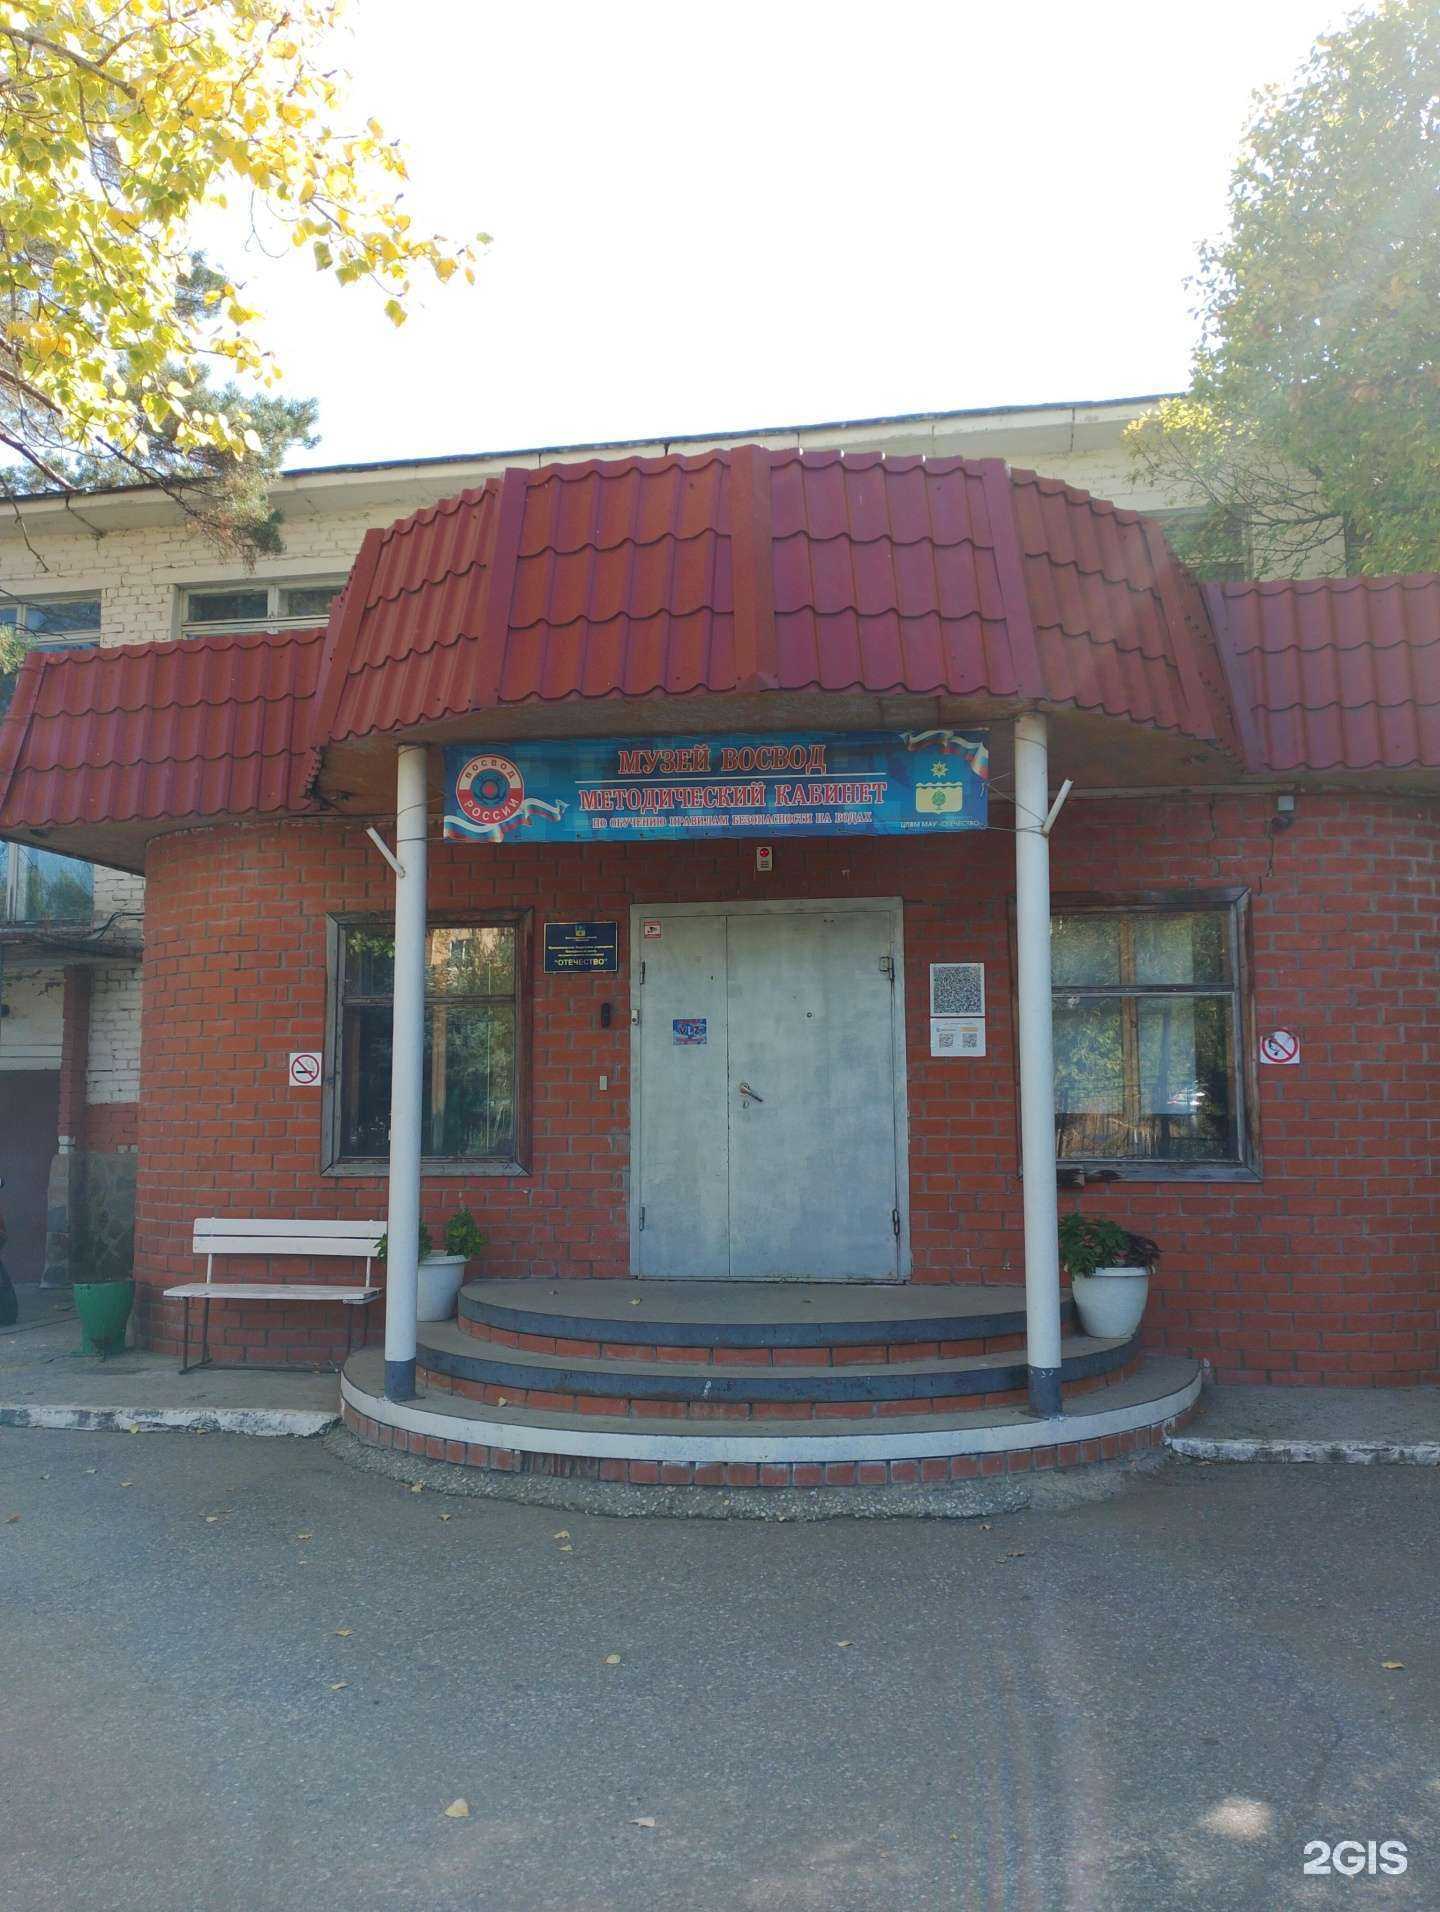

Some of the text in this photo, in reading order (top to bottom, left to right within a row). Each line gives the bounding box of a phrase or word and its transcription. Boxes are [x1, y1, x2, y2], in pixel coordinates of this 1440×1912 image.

[465, 759, 516, 780] ВОСВОД
[618, 744, 827, 775] МУЗЕЙ ВОСВОД
[579, 781, 888, 814] МЕТОДИЧЕСКИЙ КАБИНЕТ
[464, 798, 520, 821] РОССИИ
[815, 812, 832, 824] НА
[835, 811, 873, 825] ВОДАХ
